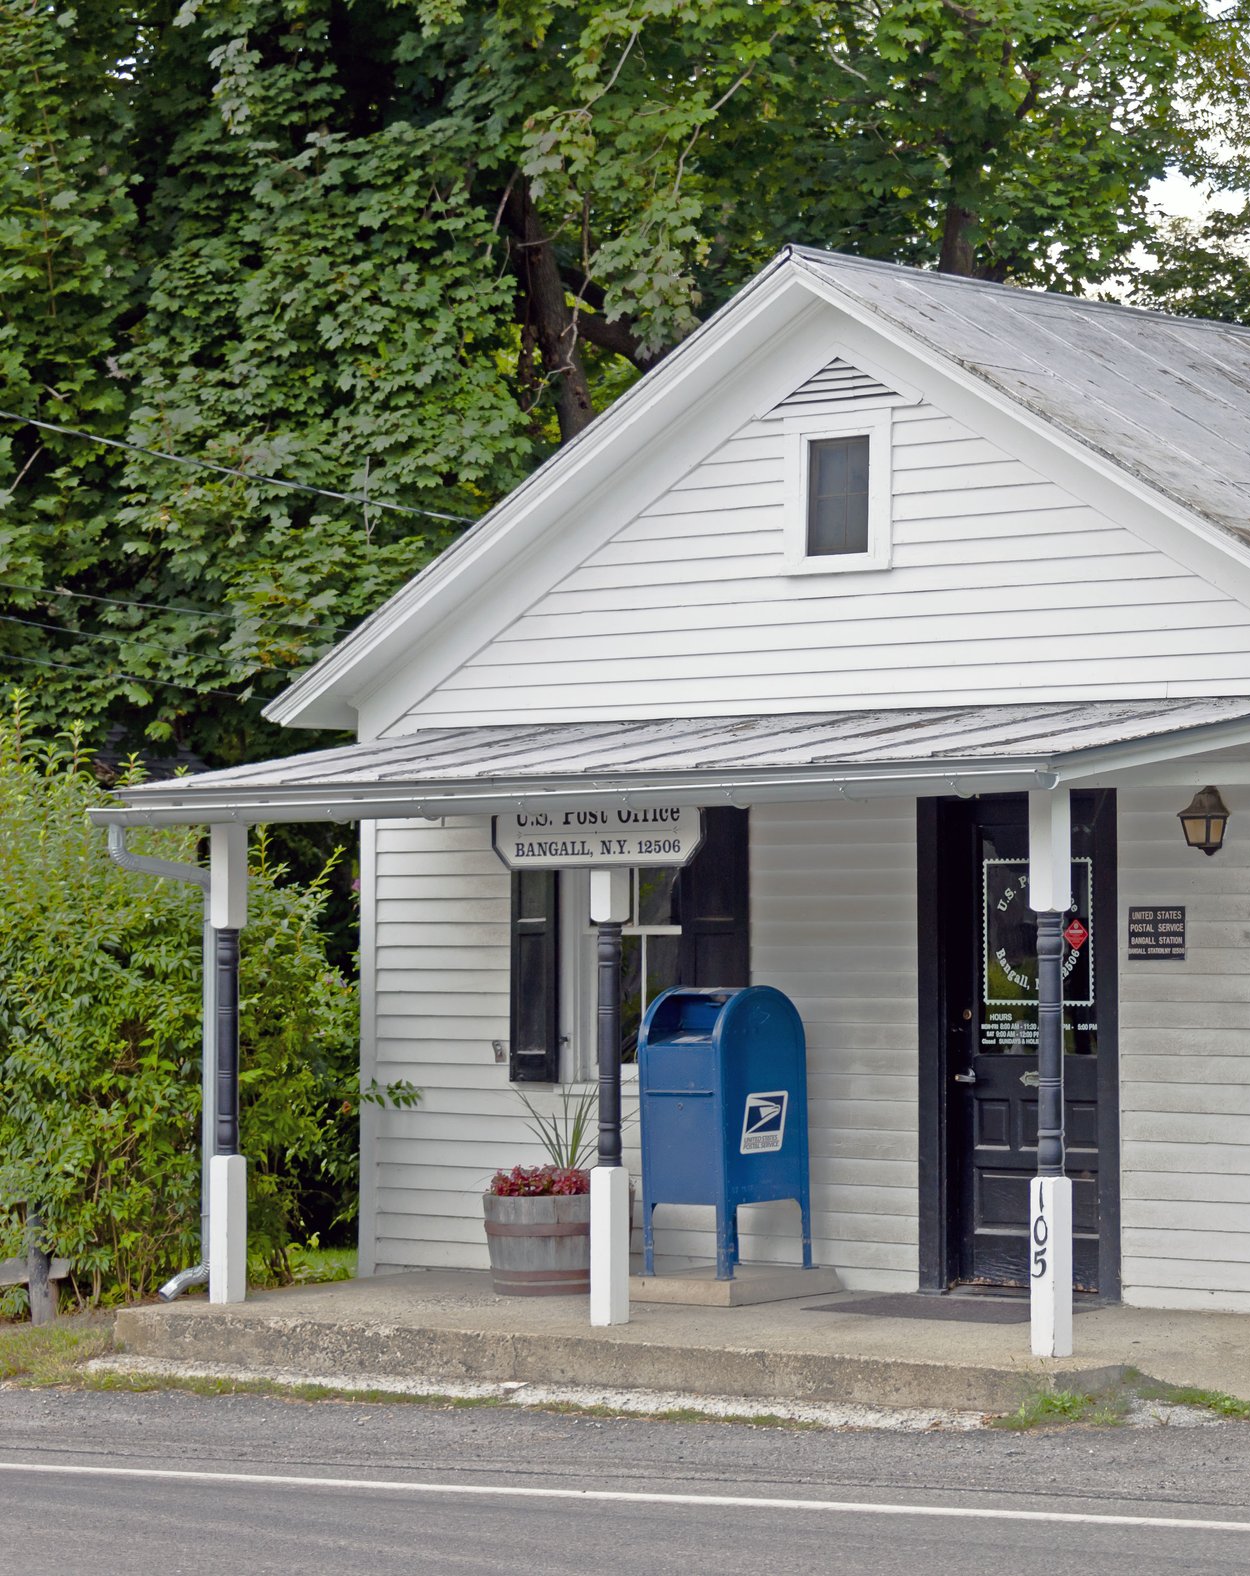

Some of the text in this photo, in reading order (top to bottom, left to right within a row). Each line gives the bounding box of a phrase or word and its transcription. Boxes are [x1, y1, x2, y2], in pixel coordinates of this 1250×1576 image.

[514, 839, 681, 858] BANGALL, N.Y. 12506
[997, 888, 1016, 912] U.S.
[1132, 911, 1182, 920] UNITED STATES
[1130, 923, 1184, 932] POSTAL SERVICE
[1131, 936, 1183, 945] BANGALL STATION
[996, 948, 1080, 990] Bangall, 2506
[990, 1013, 1013, 1021] HOURS
[1031, 1181, 1048, 1278] 105
